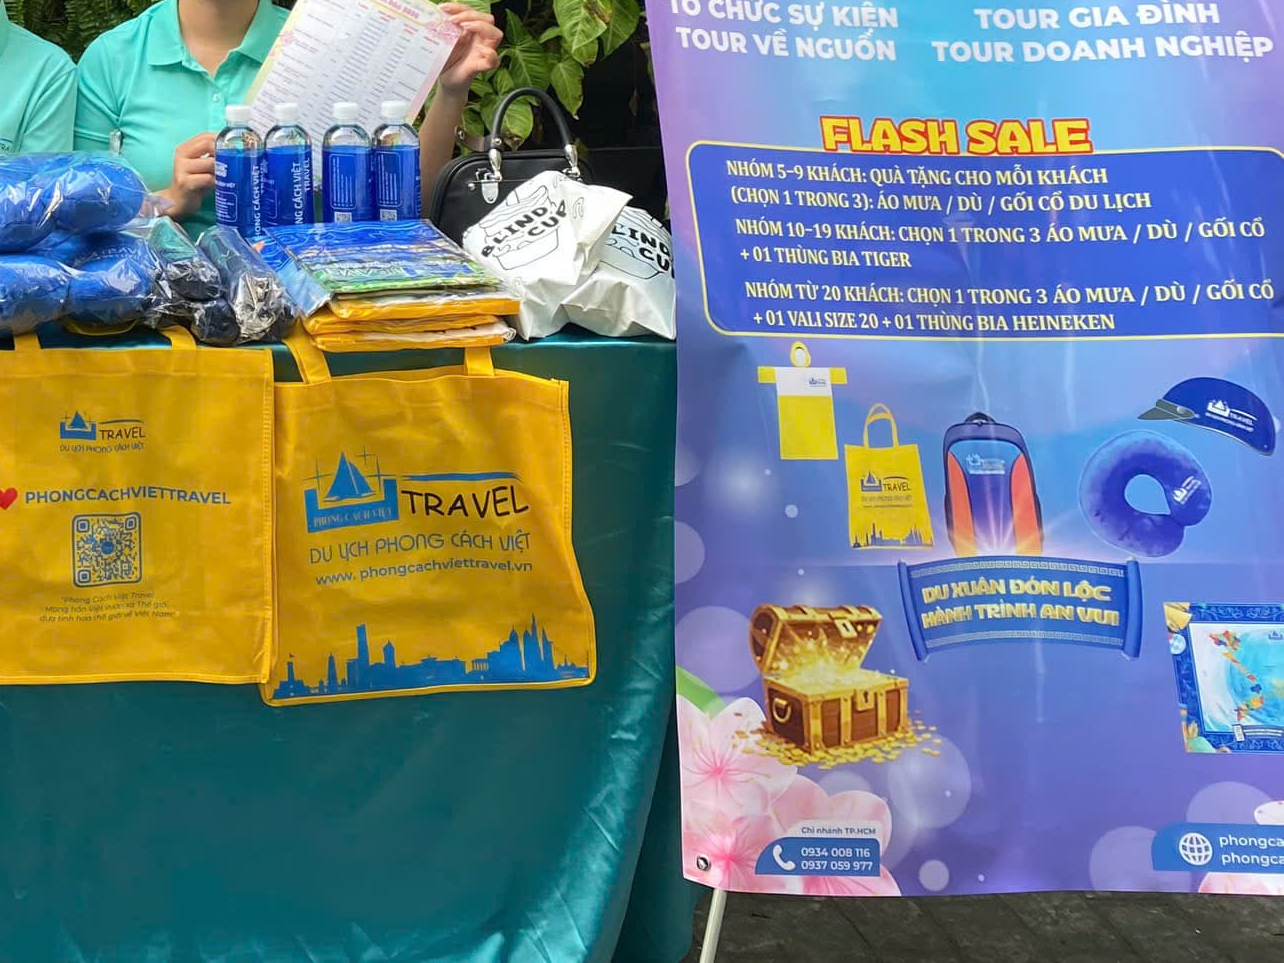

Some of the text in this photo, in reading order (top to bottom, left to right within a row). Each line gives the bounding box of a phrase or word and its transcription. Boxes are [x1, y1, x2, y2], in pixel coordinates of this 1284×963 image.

[974, 9, 1060, 30] TOUR
[1068, 5, 1130, 28] GIA
[820, 115, 1094, 155] FLASH SALE
[726, 158, 774, 179] NHÓM
[807, 164, 867, 183] KHÁCH:
[870, 168, 903, 187] QUÀ
[907, 166, 951, 188] TẶNG
[954, 170, 991, 186] CHO
[996, 165, 1033, 185] MỖI
[1036, 166, 1108, 185] KHÁCH
[481, 207, 548, 257] BLIND
[753, 246, 912, 268] 01 THÙNG BIA TIGER
[25, 486, 231, 504] PHONGCACHVIETTRAVEL
[401, 485, 529, 519] TRAVEL
[922, 576, 1111, 603] DU XUÂN ĐÓN LỘC
[922, 598, 1119, 628] HÀNH TRÌNH AN VUI
[801, 847, 870, 857] 0934 008 116
[801, 861, 873, 871] 0937 059 977
